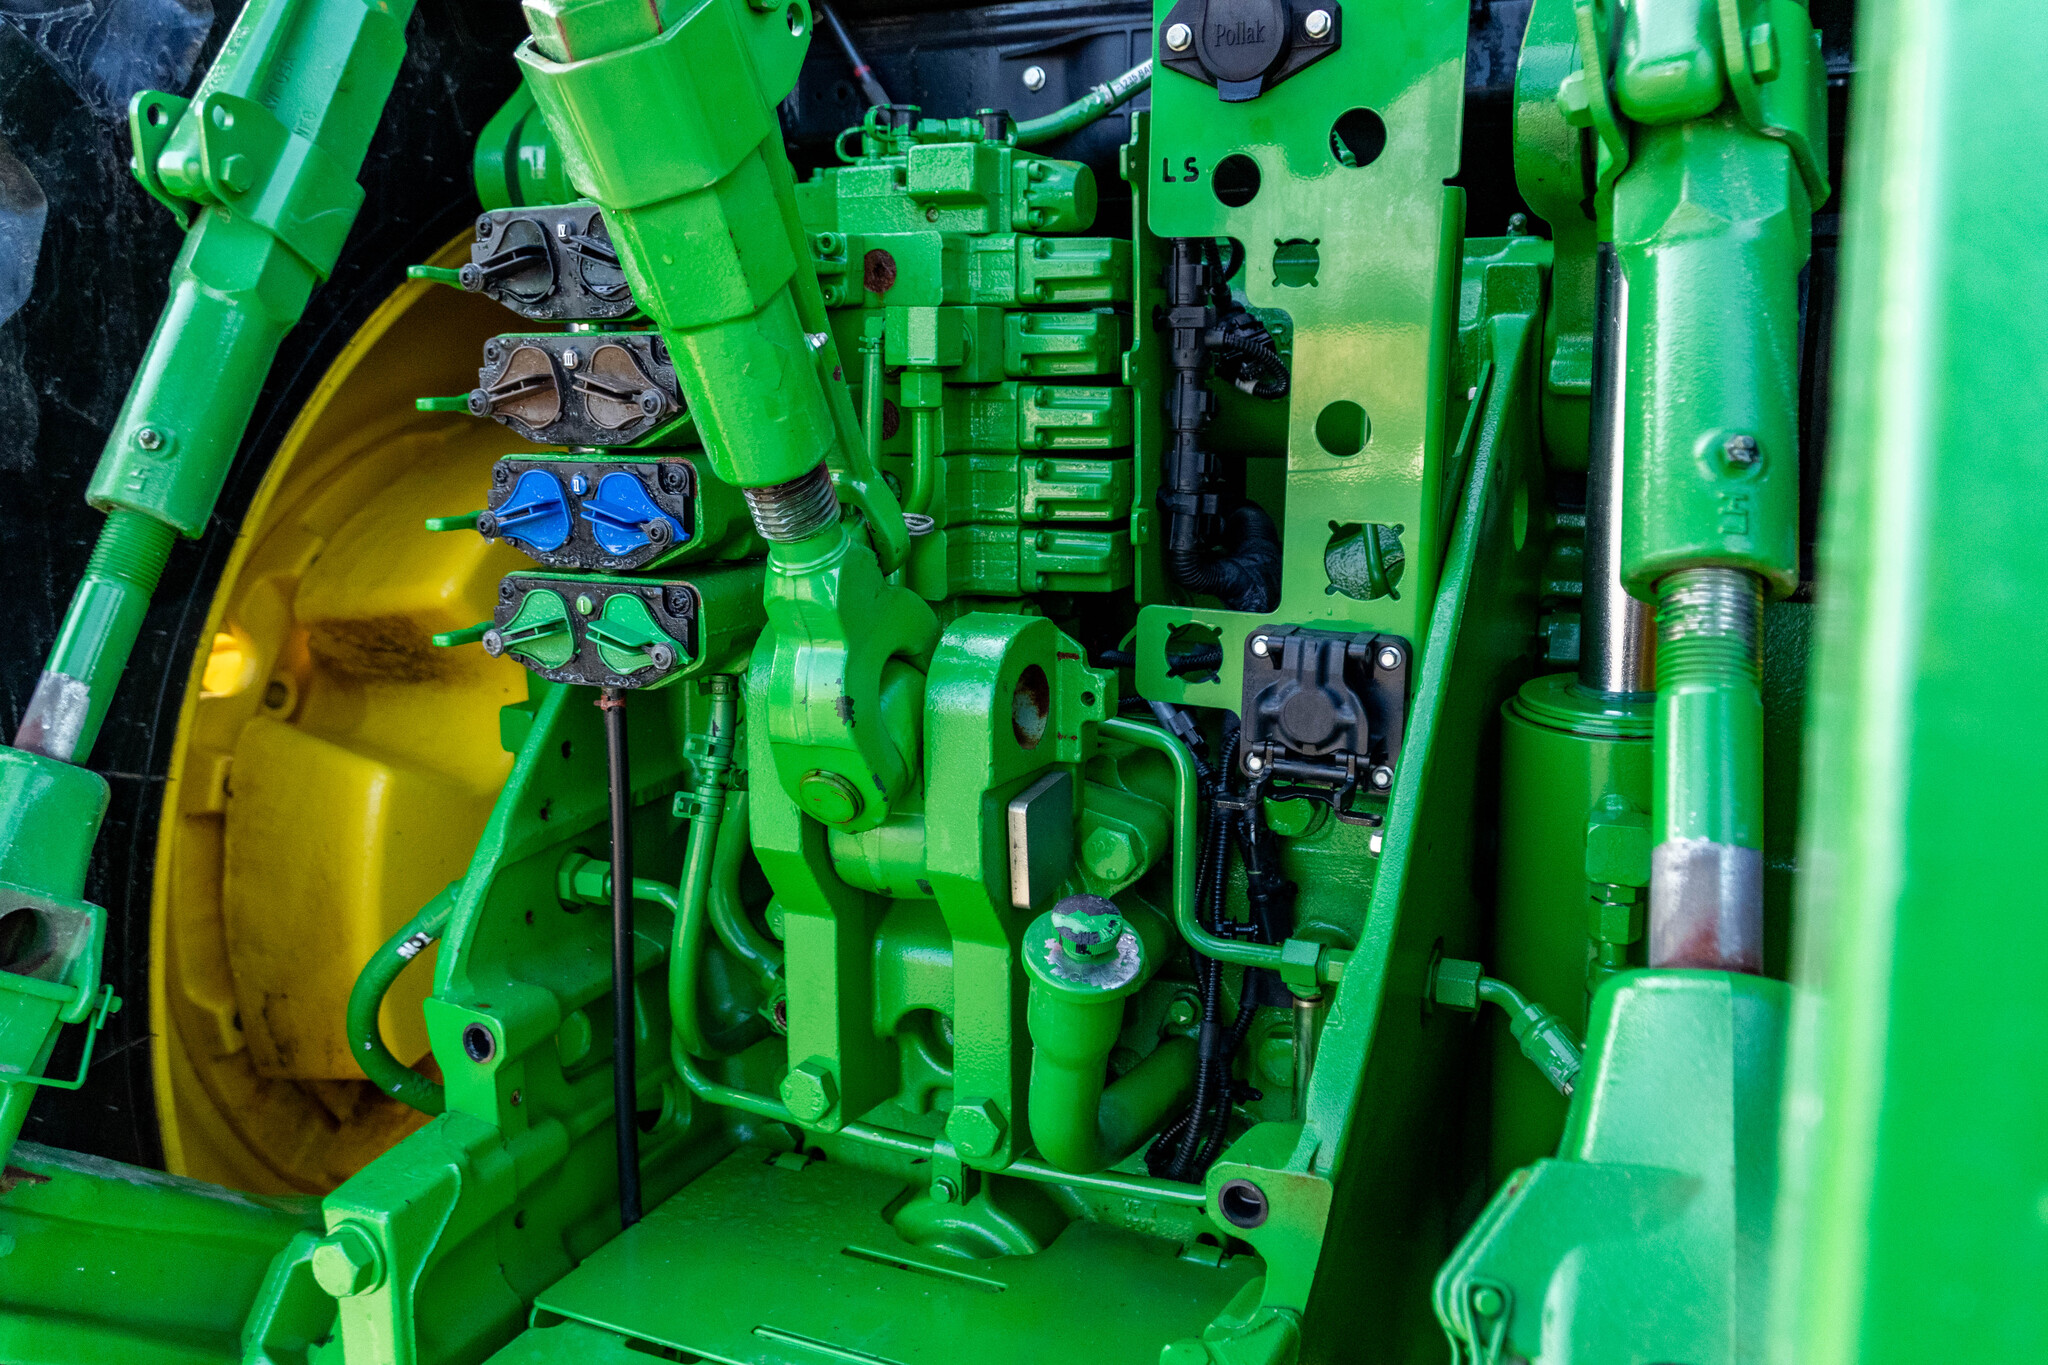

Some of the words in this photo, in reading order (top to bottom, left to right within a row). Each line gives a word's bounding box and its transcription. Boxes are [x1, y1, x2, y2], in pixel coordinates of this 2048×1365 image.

[1215, 19, 1266, 47] Pollak
[1162, 157, 1199, 182] LS
[557, 223, 567, 238] IV
[563, 352, 574, 367] III
[573, 479, 580, 492] II
